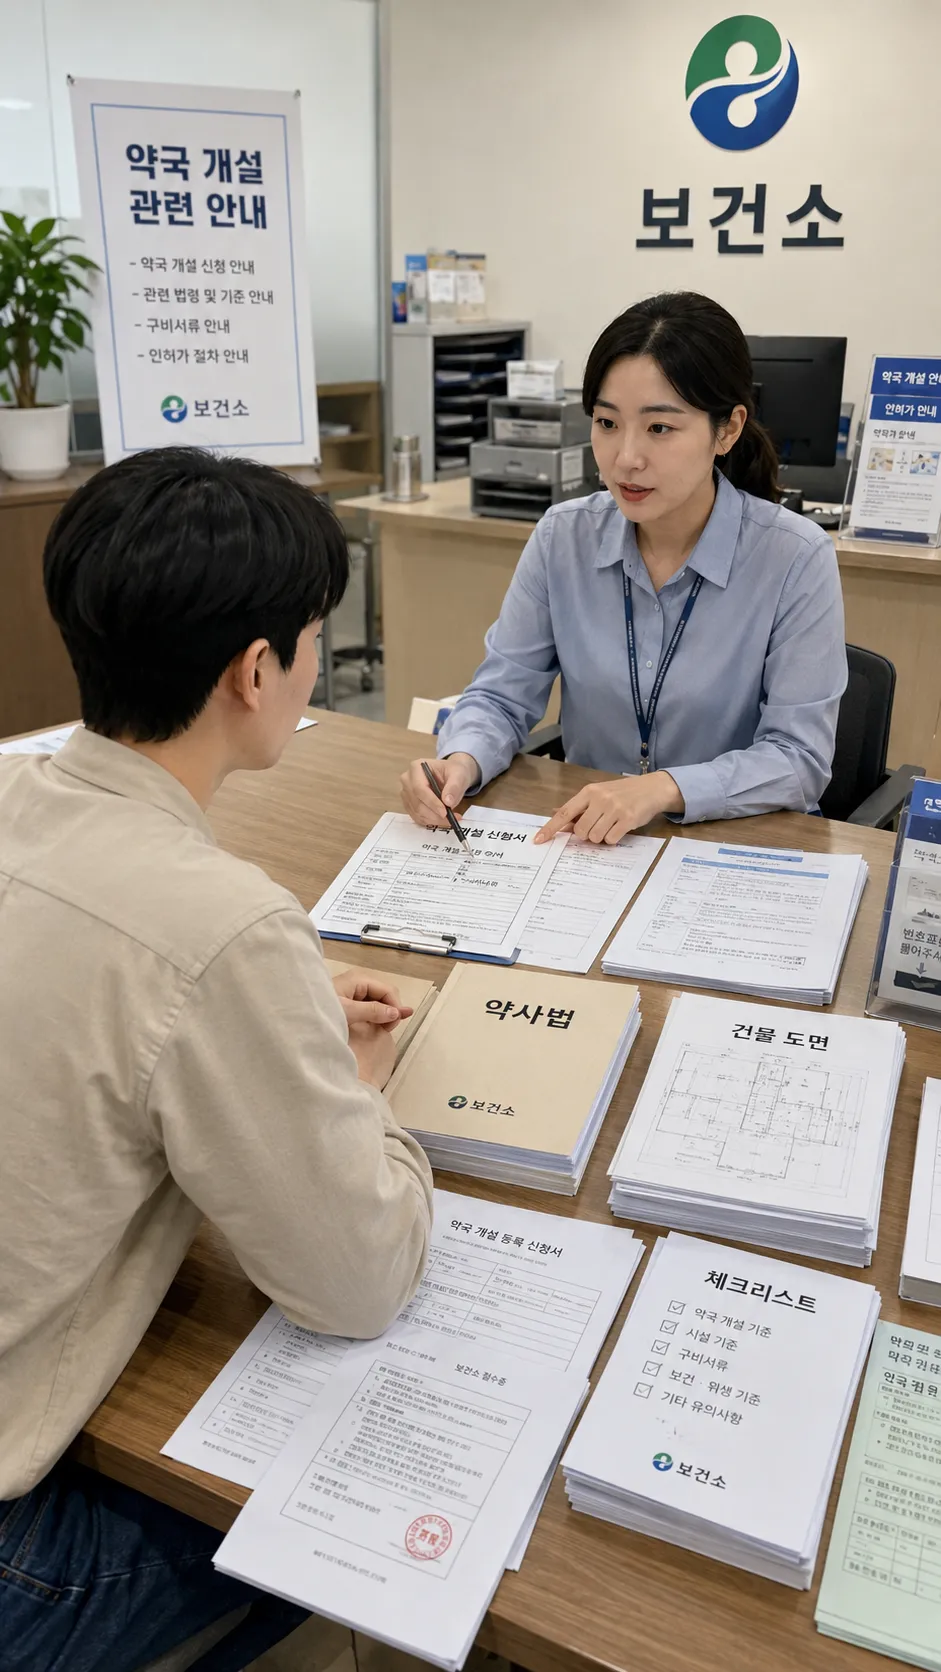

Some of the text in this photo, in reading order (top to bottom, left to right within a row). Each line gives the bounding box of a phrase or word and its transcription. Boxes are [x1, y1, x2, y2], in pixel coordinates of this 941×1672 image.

[125, 143, 264, 185] 약국 개설
[129, 190, 268, 230] 관련 안내
[635, 183, 844, 254] 보건소
[140, 256, 167, 272] 약국
[171, 257, 197, 273] 개설
[201, 258, 226, 274] 신청
[229, 259, 255, 275] 안내
[143, 287, 170, 303] 관련
[174, 288, 200, 304] 법령
[203, 288, 217, 304] 및
[220, 289, 245, 305] 기준
[248, 289, 274, 305] 안내
[146, 318, 200, 334] 구비서류
[204, 318, 231, 334] 안내
[148, 348, 190, 364] 인허가
[193, 348, 220, 364] 절차
[223, 348, 249, 364] 안내
[193, 398, 250, 419] 보건소
[485, 999, 575, 1030] 약사법
[731, 1023, 830, 1052] 건물 도면
[470, 1100, 515, 1117] 보건소
[527, 1240, 564, 1258] 신청서
[704, 1269, 817, 1314] 체크리스트
[685, 1328, 738, 1352] 시설 기준
[720, 1315, 745, 1331] 개설
[747, 1323, 772, 1339] 기준
[678, 1347, 729, 1373] 구비서류
[668, 1369, 695, 1387] 보건
[707, 1380, 733, 1398] 위생
[735, 1389, 761, 1407] 기준
[660, 1391, 744, 1427] 기타 유의사항
[676, 1460, 728, 1490] 보건소
